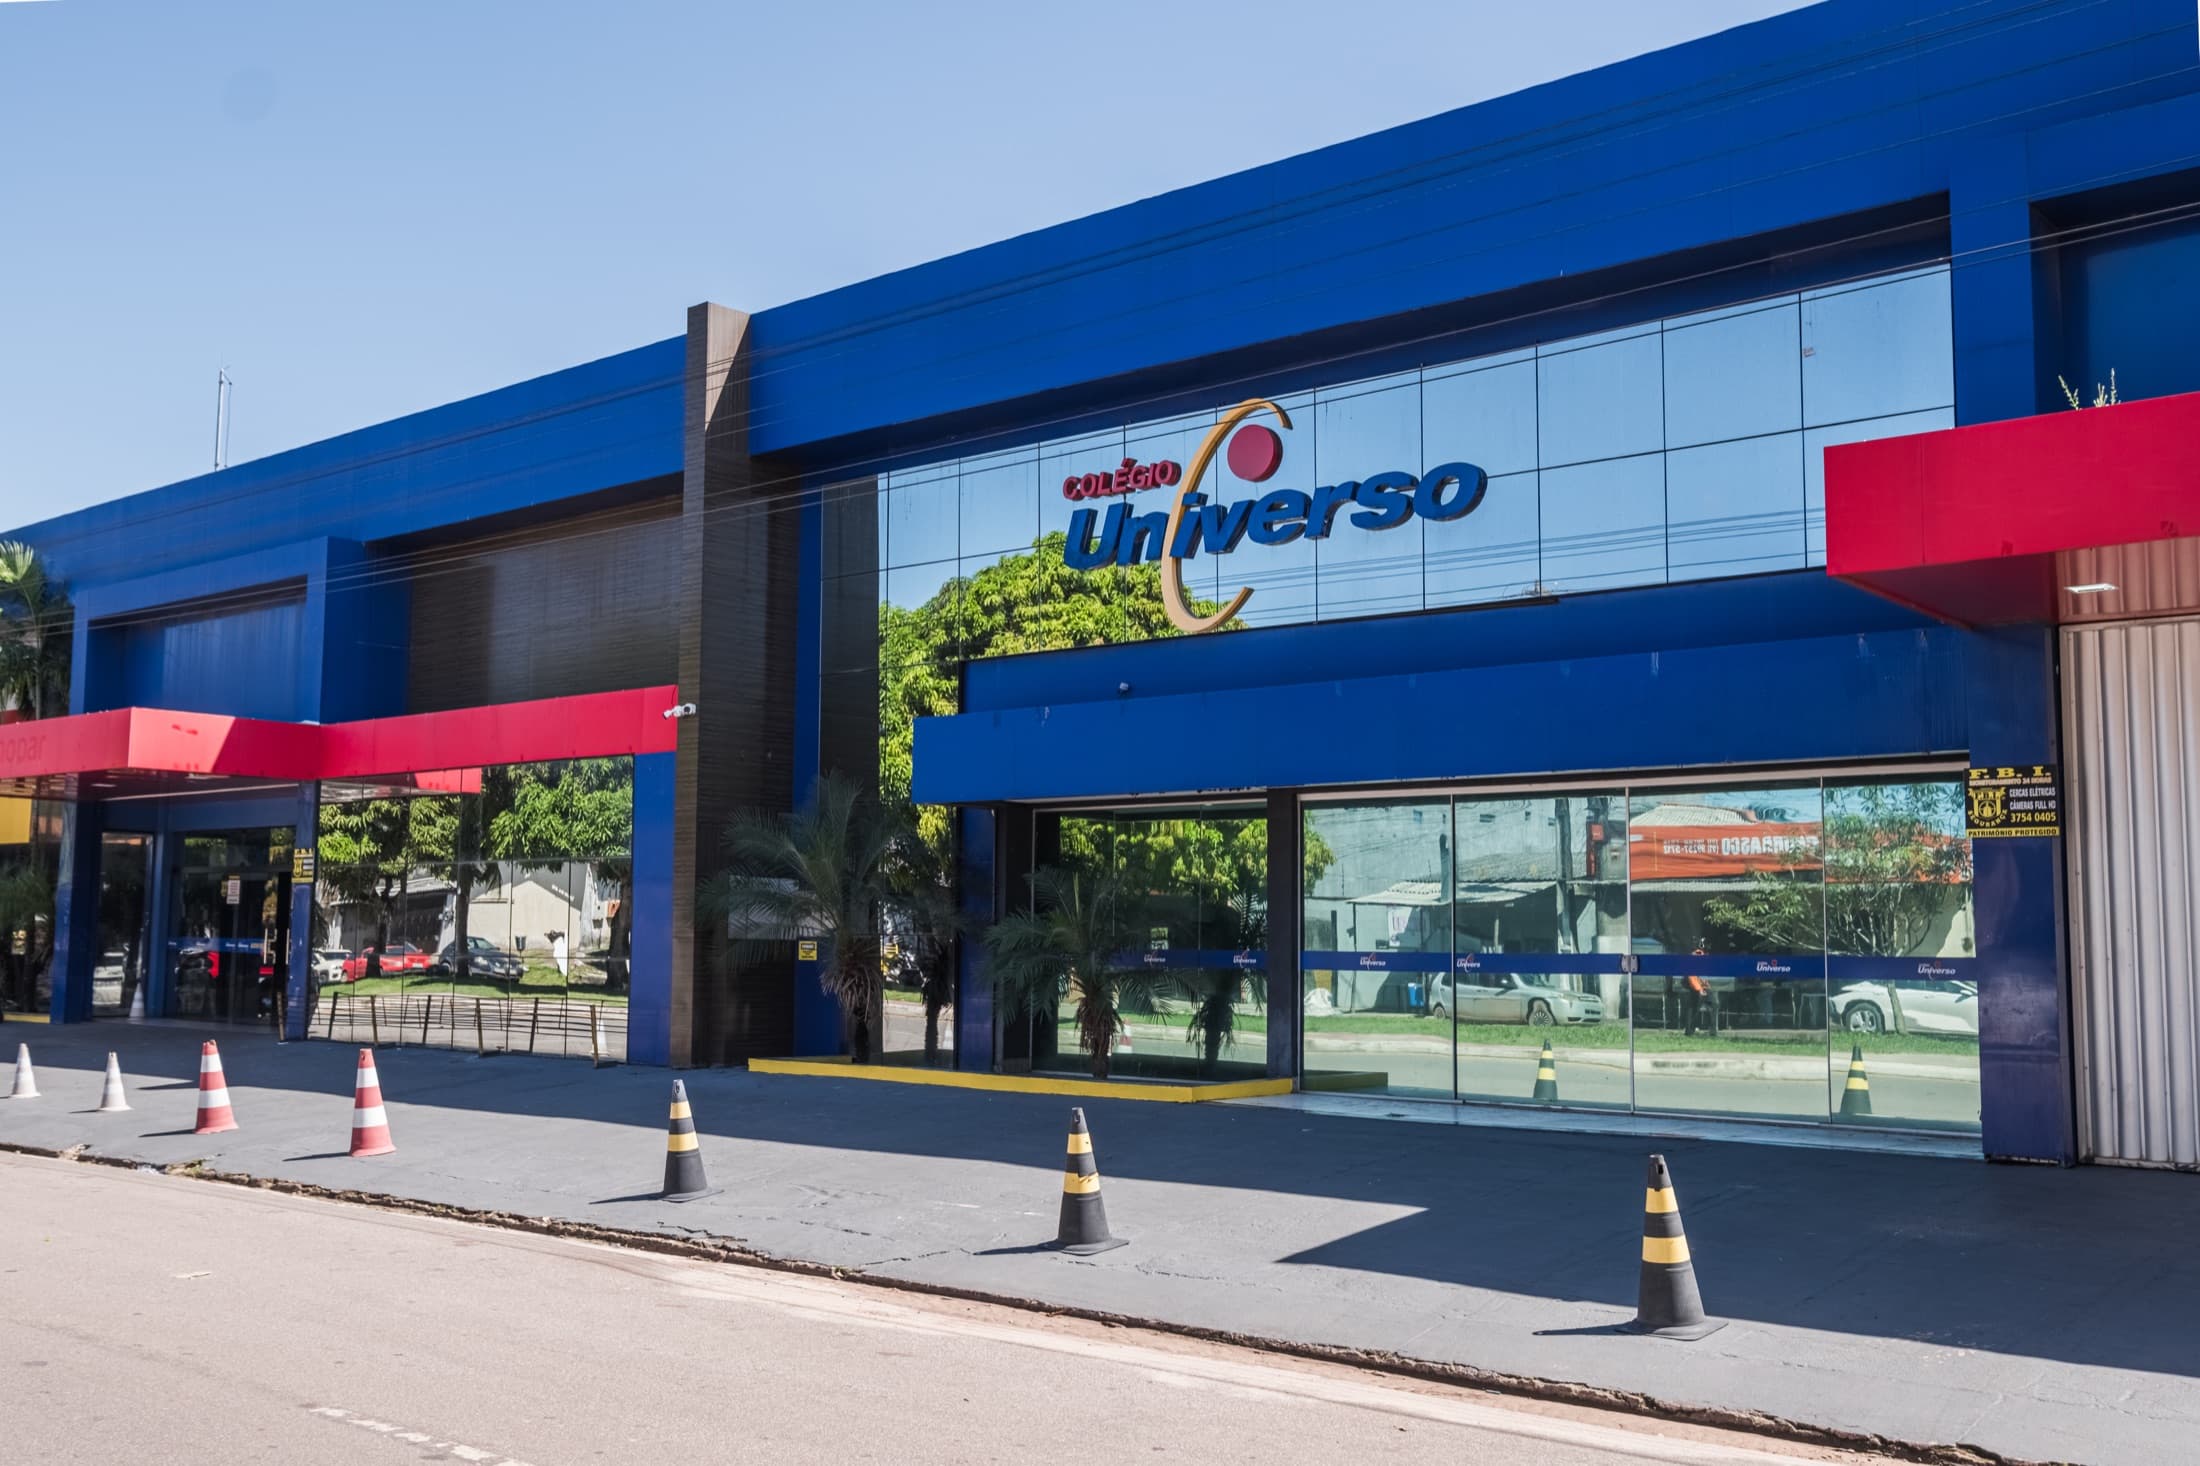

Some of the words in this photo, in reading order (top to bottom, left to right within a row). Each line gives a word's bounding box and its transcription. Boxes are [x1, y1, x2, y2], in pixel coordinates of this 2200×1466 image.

[1063, 457, 1182, 501] COLÉGIO
[1063, 461, 1488, 571] Universo
[2009, 788, 2028, 797] CERCAS
[2029, 786, 2056, 797] ELÉTRICAS
[2034, 800, 2047, 809] FULL
[2010, 812, 2032, 823] 3754
[2034, 811, 2056, 822] 0405
[2014, 827, 2057, 836] PROTEGIDO
[1756, 962, 1791, 972] Universo
[1917, 964, 1956, 976] Universo
